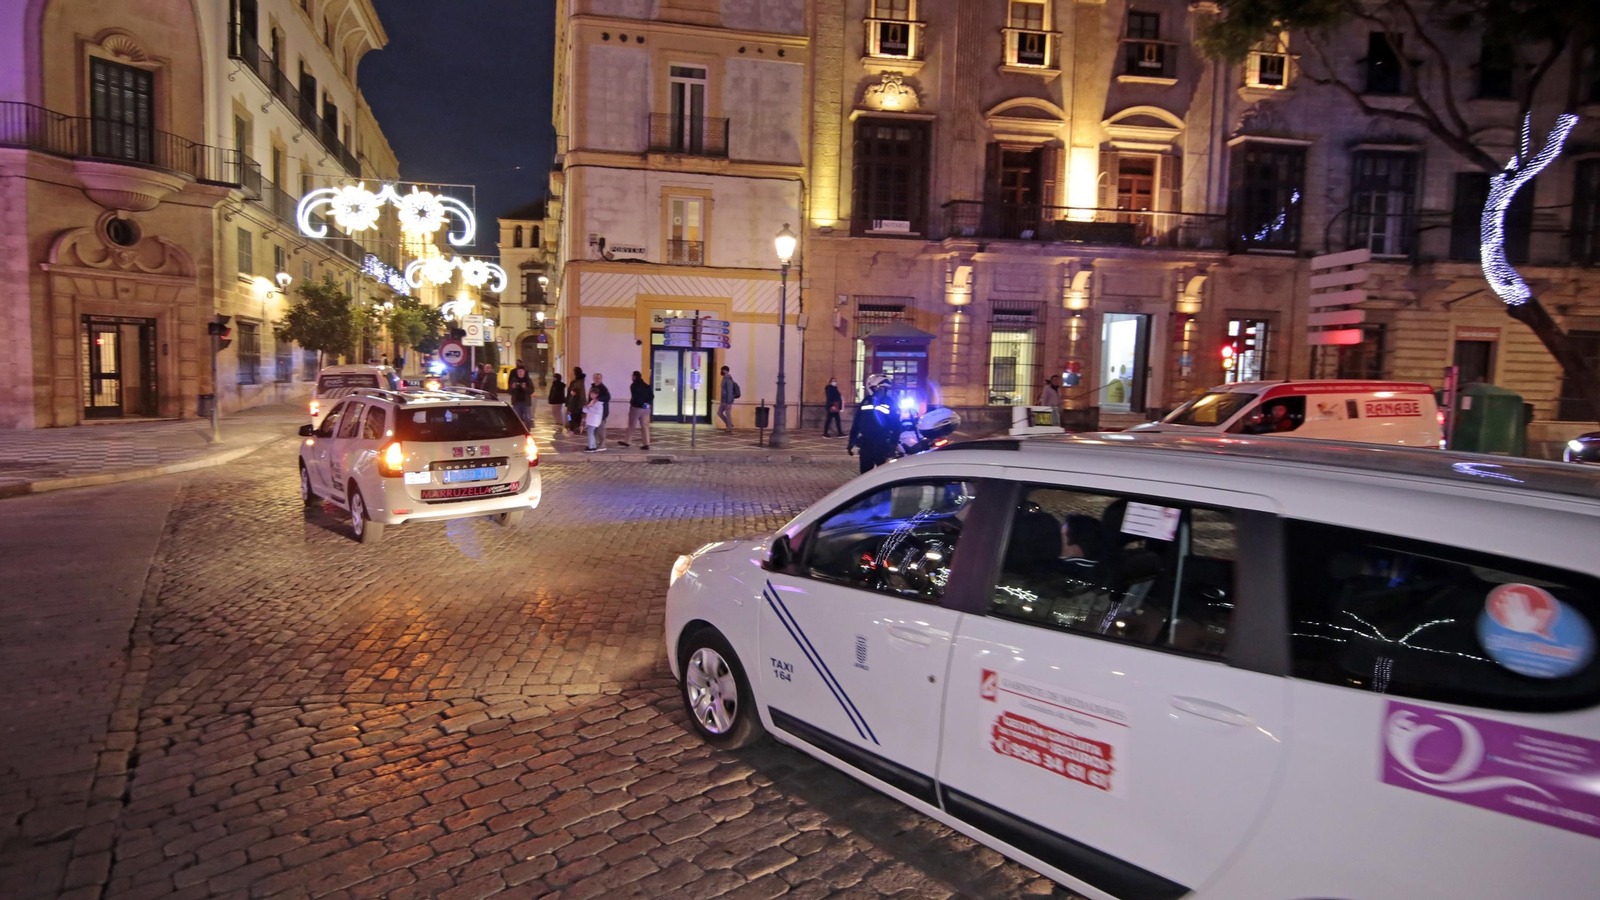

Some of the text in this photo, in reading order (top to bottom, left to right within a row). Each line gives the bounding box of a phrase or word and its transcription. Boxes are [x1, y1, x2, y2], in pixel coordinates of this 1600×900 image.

[1365, 402, 1420, 414] RANABE
[421, 486, 491, 498] MARRUZELLA
[770, 657, 794, 673] TAXI
[773, 669, 792, 682] 164
